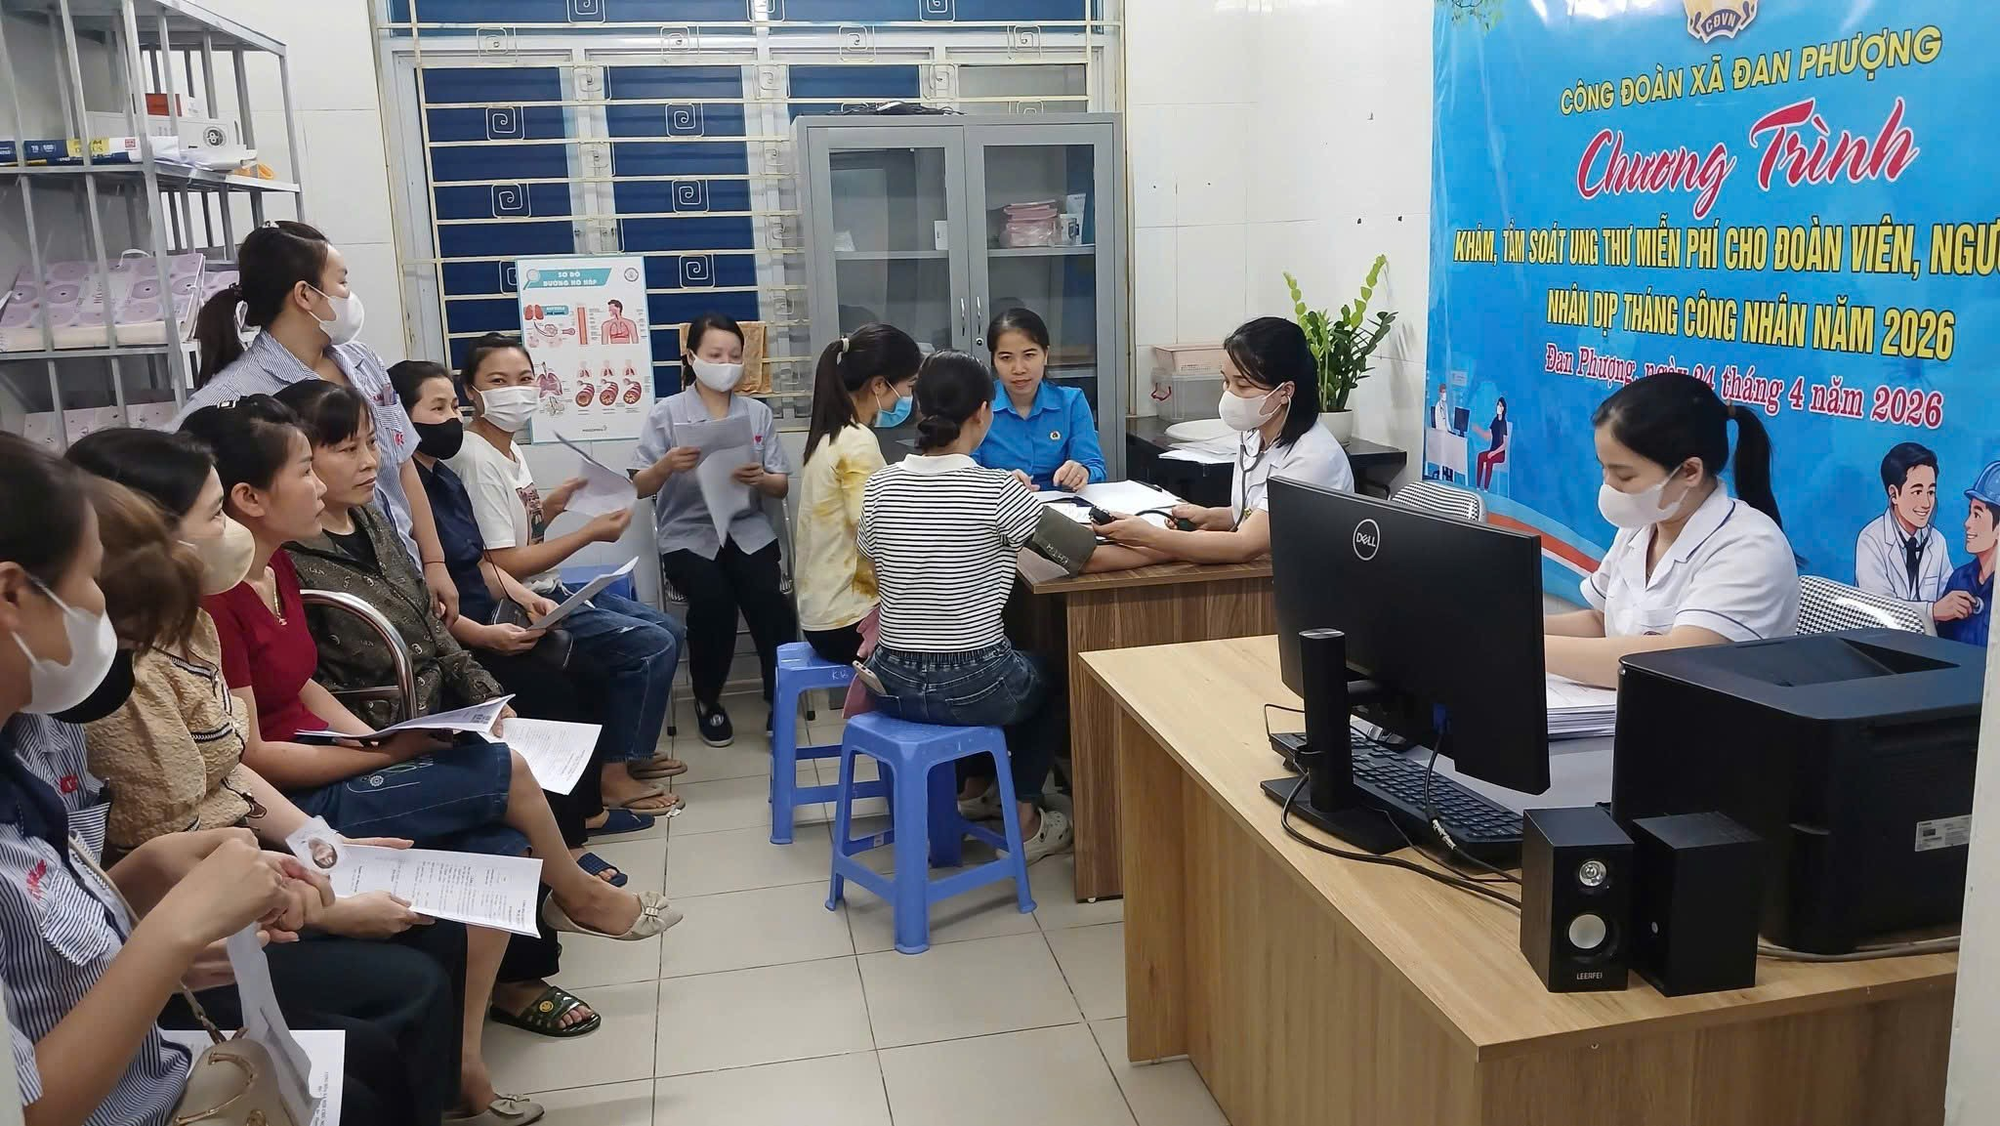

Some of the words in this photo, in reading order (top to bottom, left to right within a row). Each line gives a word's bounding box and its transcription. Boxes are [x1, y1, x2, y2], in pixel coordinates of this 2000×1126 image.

[1705, 12, 1736, 33] CĐVN
[1560, 78, 1615, 115] CÔNG
[1619, 63, 1684, 107] ĐOÀN
[1689, 54, 1725, 97] XÃ
[1732, 49, 1792, 90] ĐAN
[1798, 25, 1943, 81] PHƯỢNG
[1576, 128, 1737, 220] Chương
[1749, 96, 1920, 192] Trình
[1453, 223, 1498, 266] KHÁM,
[1502, 218, 1526, 264] TẦM
[1528, 221, 1567, 264] SOÁT
[1569, 228, 1599, 266] UNG
[1601, 224, 1634, 267] THƯ
[1635, 212, 1682, 268] MIỄN
[1685, 218, 1721, 269] PHÍ
[1724, 226, 1769, 271] CHO
[1773, 215, 1843, 272] ĐOÀN
[1850, 213, 1921, 281] VIÊN,
[1929, 217, 2000, 276] NGƯ
[1546, 282, 1590, 327] NHÂN
[1592, 291, 1619, 337] DỊP
[1623, 286, 1679, 336] THÁNG
[1683, 289, 1738, 342] CÔNG
[1742, 292, 1807, 348] NHÂN
[1812, 295, 1875, 354] NĂM
[1880, 308, 1955, 361] 2026
[1545, 342, 1574, 376] Đan
[1721, 366, 1784, 415] tháng
[1788, 376, 1805, 410] 4
[1810, 376, 1863, 417] năm
[1870, 385, 1944, 429] 2026
[1356, 532, 1376, 547] DELL
